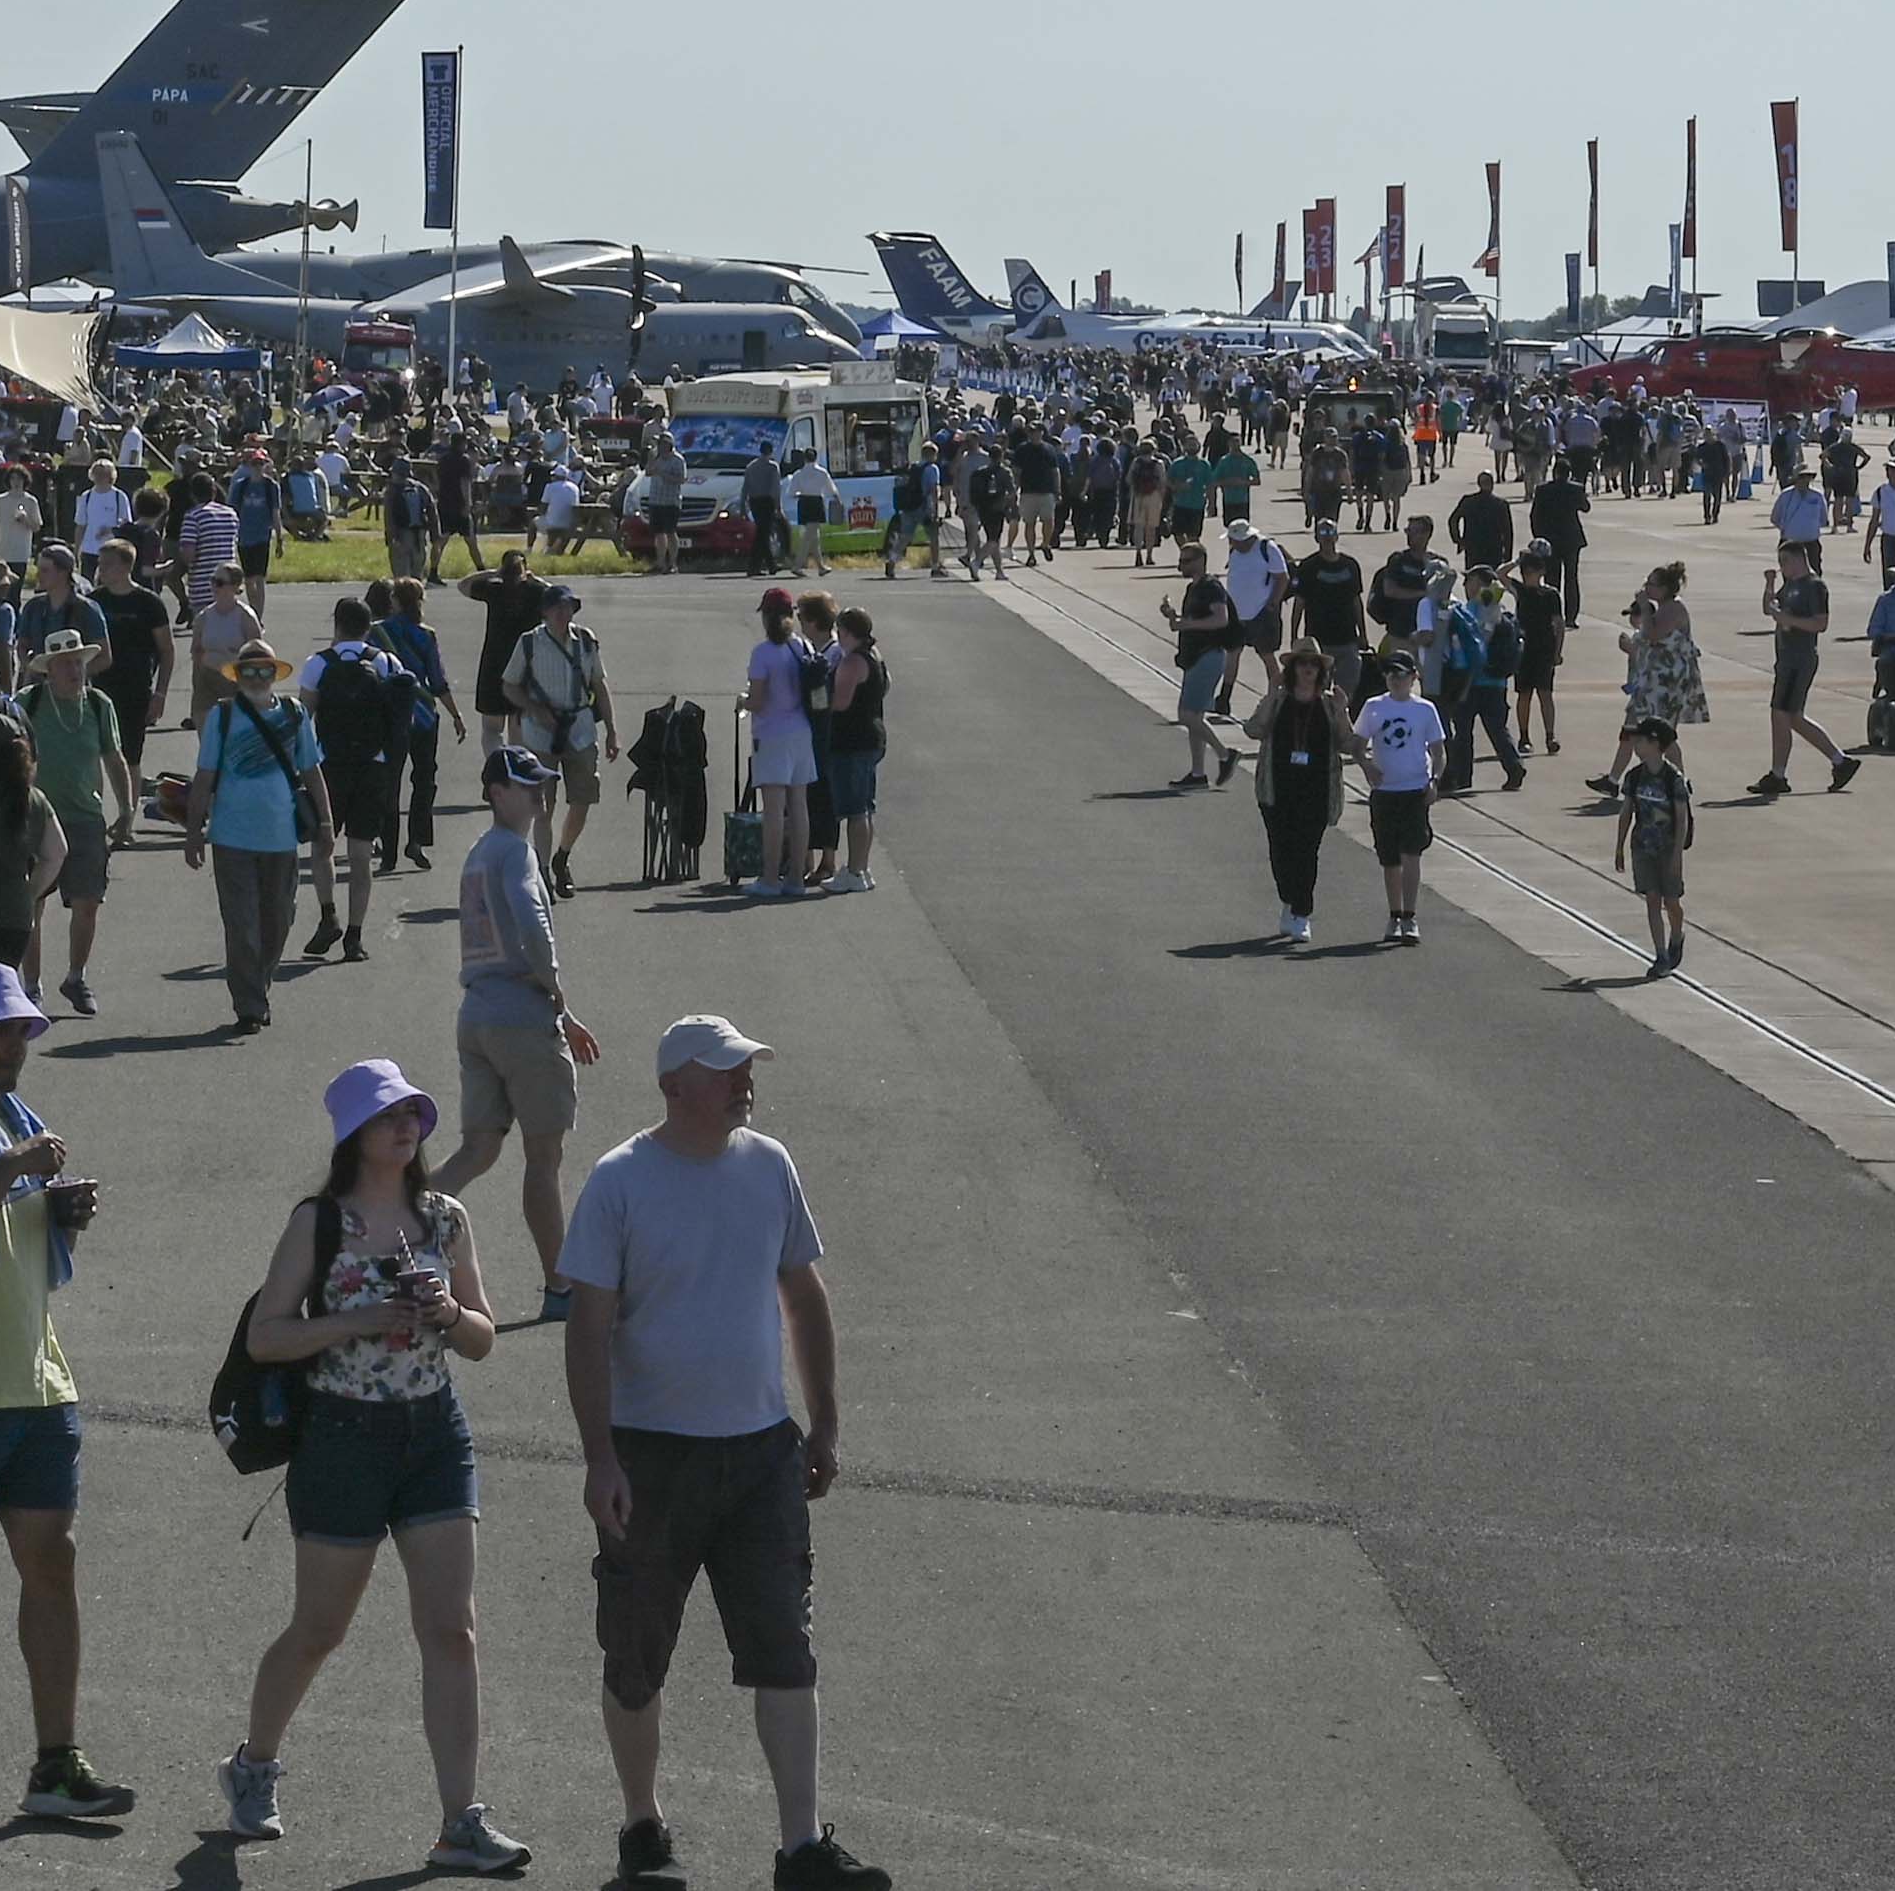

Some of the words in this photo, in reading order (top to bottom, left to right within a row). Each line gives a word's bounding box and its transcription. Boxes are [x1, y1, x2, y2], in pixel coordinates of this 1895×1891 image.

[152, 88, 189, 102] PAPA
[440, 86, 453, 150] OFFICIAL
[426, 86, 441, 193] MERCHANDISE
[1780, 142, 1797, 209] 18
[1388, 214, 1403, 259] 22
[917, 246, 973, 310] FAAM
